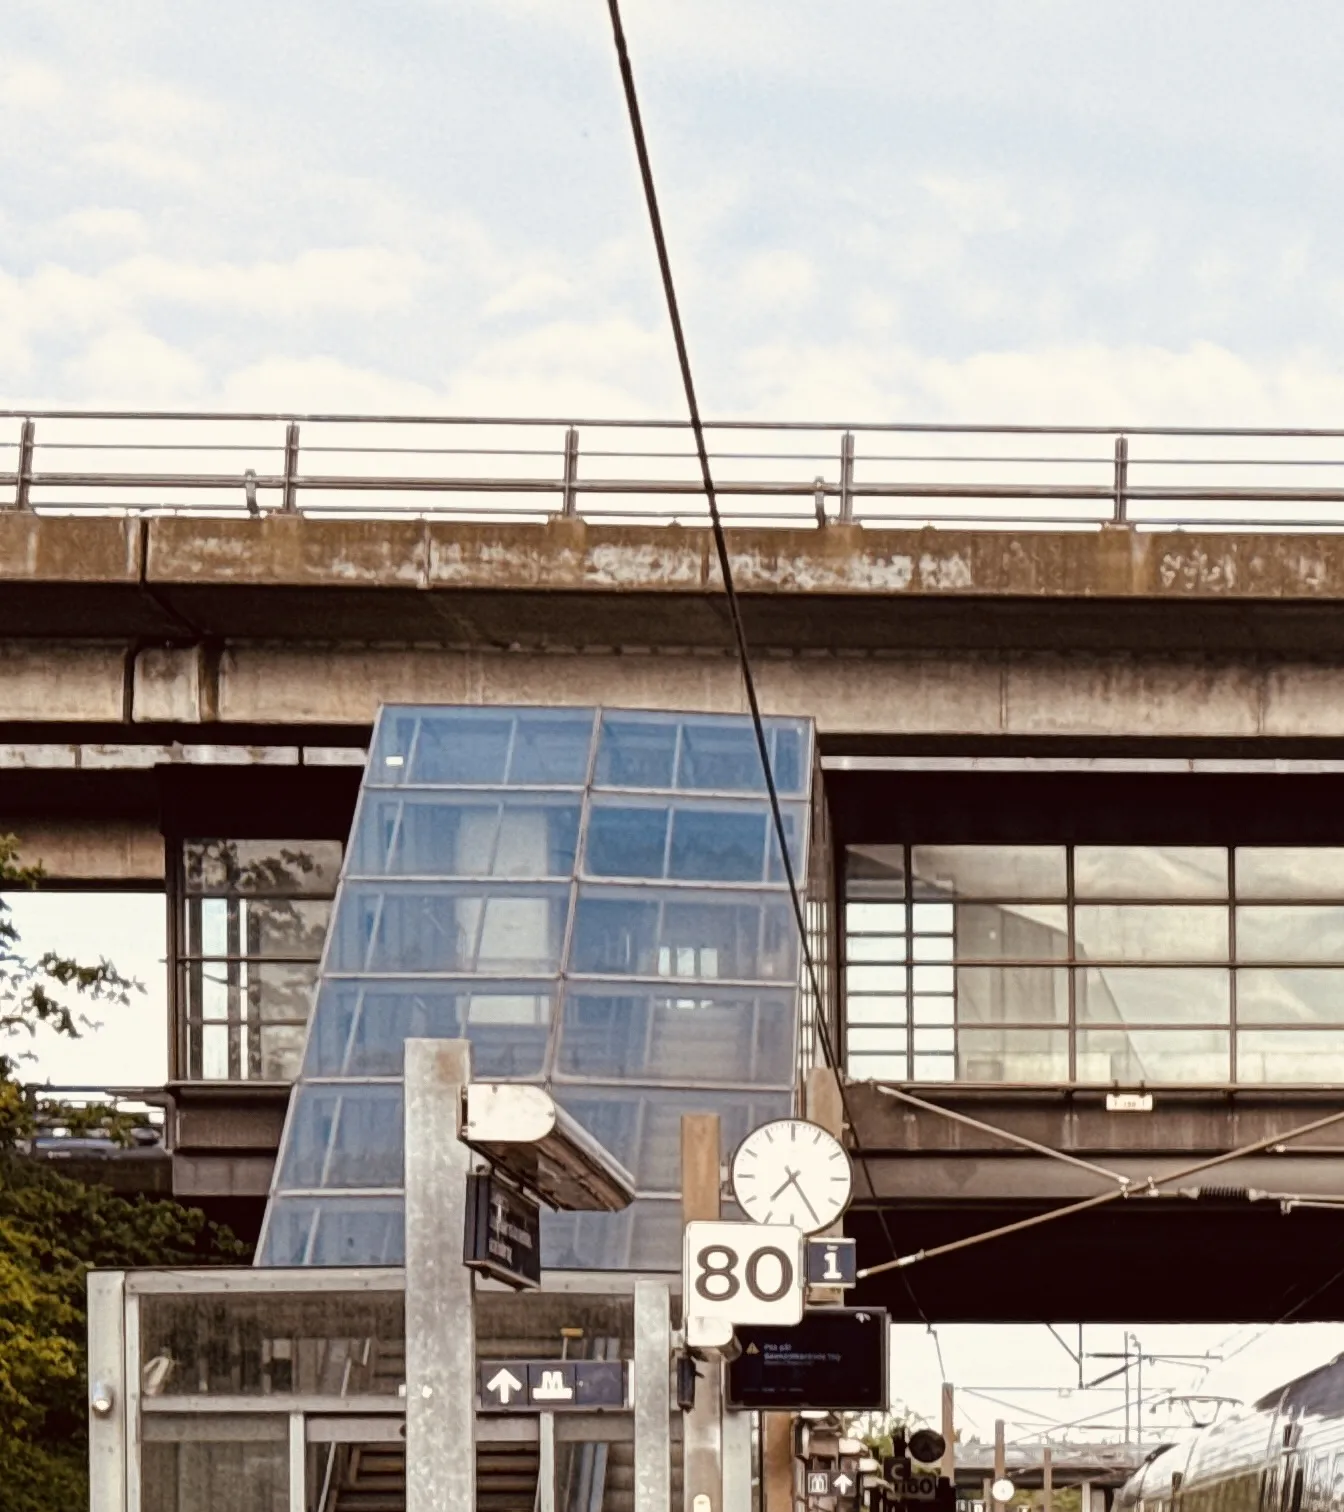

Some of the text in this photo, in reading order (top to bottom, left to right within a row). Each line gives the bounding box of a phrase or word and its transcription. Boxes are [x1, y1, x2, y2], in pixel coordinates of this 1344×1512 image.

[695, 1244, 793, 1302] 80
[823, 1252, 842, 1280] 1
[891, 1463, 904, 1480] C
